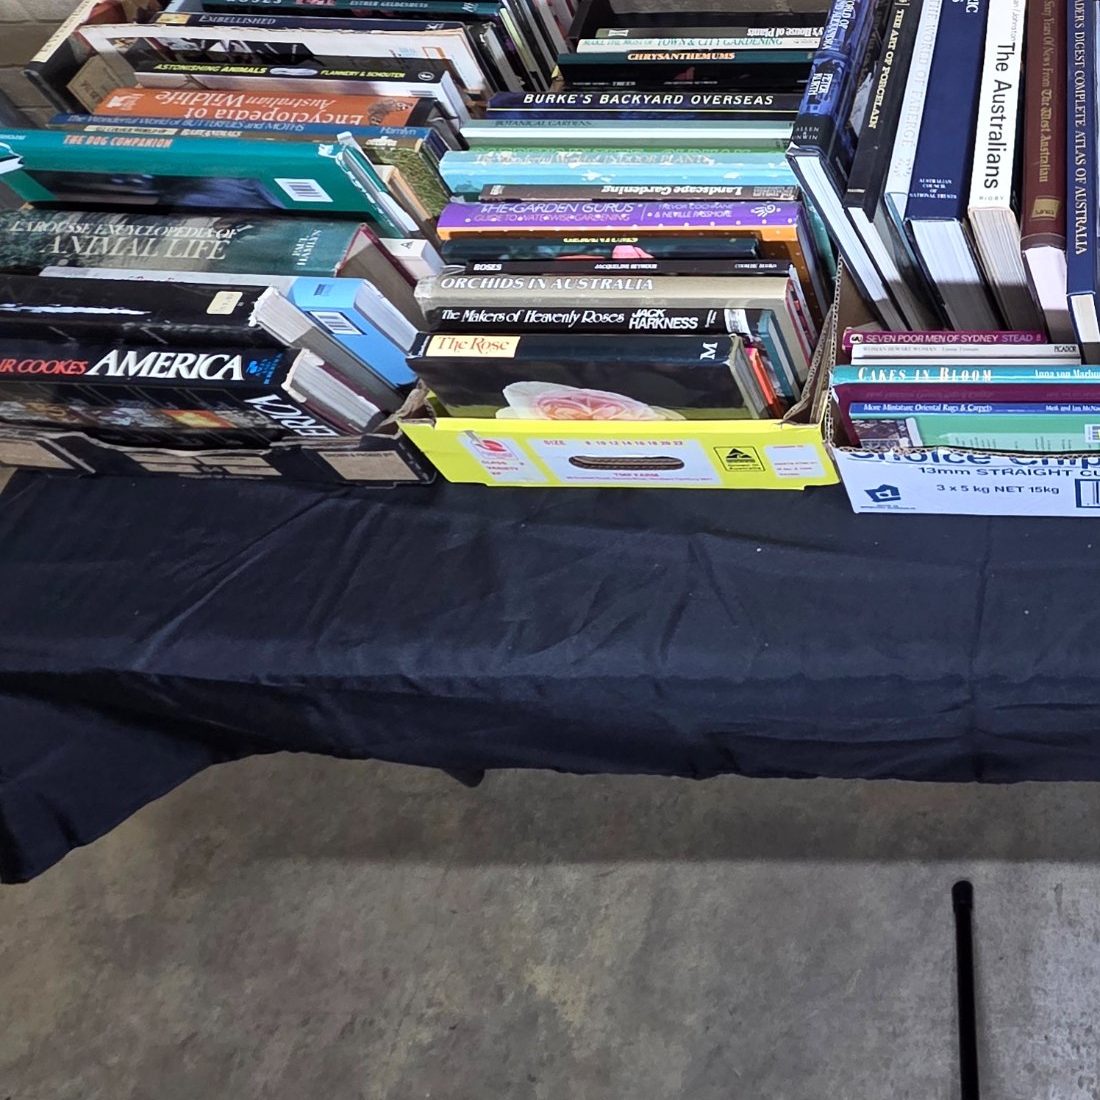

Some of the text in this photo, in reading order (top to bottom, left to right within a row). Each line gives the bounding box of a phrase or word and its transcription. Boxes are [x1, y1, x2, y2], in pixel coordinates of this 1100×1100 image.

[198, 14, 277, 26] EMBELLISHED
[747, 27, 808, 38] House of Plants
[657, 38, 687, 47] TOWN
[723, 37, 783, 46] GARDENING
[627, 52, 736, 61] CHRYSANTHEMUMS
[1042, 47, 1055, 66] News
[1074, 31, 1086, 68] DIGEST
[153, 64, 268, 75] ASTONISHING ANIMALS
[320, 69, 358, 77] FLANNERY
[868, 8, 905, 129] THE ART OF PORCELAIN
[1042, 68, 1054, 88] From
[154, 90, 336, 110] Australian Wildlife
[523, 93, 774, 106] BURKE'S BACKYARD OVERSEAS
[1040, 88, 1052, 106] The
[1074, 70, 1087, 128] COMPLETE
[184, 107, 364, 126] Encyclopedia of
[983, 42, 1016, 189] The Australians
[1040, 106, 1052, 133] West
[265, 123, 306, 132] MOTHS
[379, 126, 418, 138] Hamlyn
[63, 134, 174, 148] THE DOG COMPANION
[1075, 130, 1087, 165] ATLAS
[1039, 134, 1052, 183] Australian
[1075, 167, 1087, 186] OF
[600, 185, 673, 196] Gardening
[673, 186, 744, 196] Landscape
[481, 202, 634, 214] THE GARDEN GURUS
[1075, 187, 1088, 255] AUSTRALIA
[10, 220, 214, 238] LAROUSSE ENCYCLOPEDIA
[39, 235, 231, 260] ANIMAL LIFE
[440, 277, 654, 290] ORCHIDS IN AUSTRALIA
[441, 309, 625, 328] The Makers of Heavenly Roses
[631, 308, 667, 318] JACK
[628, 317, 699, 330] HARKNESS
[438, 336, 510, 355] The Rose
[866, 334, 1034, 343] SEVEN POOR MEN OF SYDNEY STEAD
[700, 342, 718, 360] M
[1054, 345, 1077, 353] PICADOR
[84, 349, 245, 381] AMERICA
[915, 368, 930, 381] IN
[939, 366, 993, 382] BLOOM
[1034, 368, 1055, 379] Anna
[863, 403, 881, 411] More
[882, 403, 914, 411] Miniature
[914, 403, 941, 411] Oriental
[942, 403, 959, 412] Rugs
[967, 404, 993, 413] Carpets
[918, 467, 971, 476] 13mm
[976, 468, 1073, 477] STRAIGHT
[973, 485, 990, 494] kg
[1028, 486, 1060, 494] 15kg
